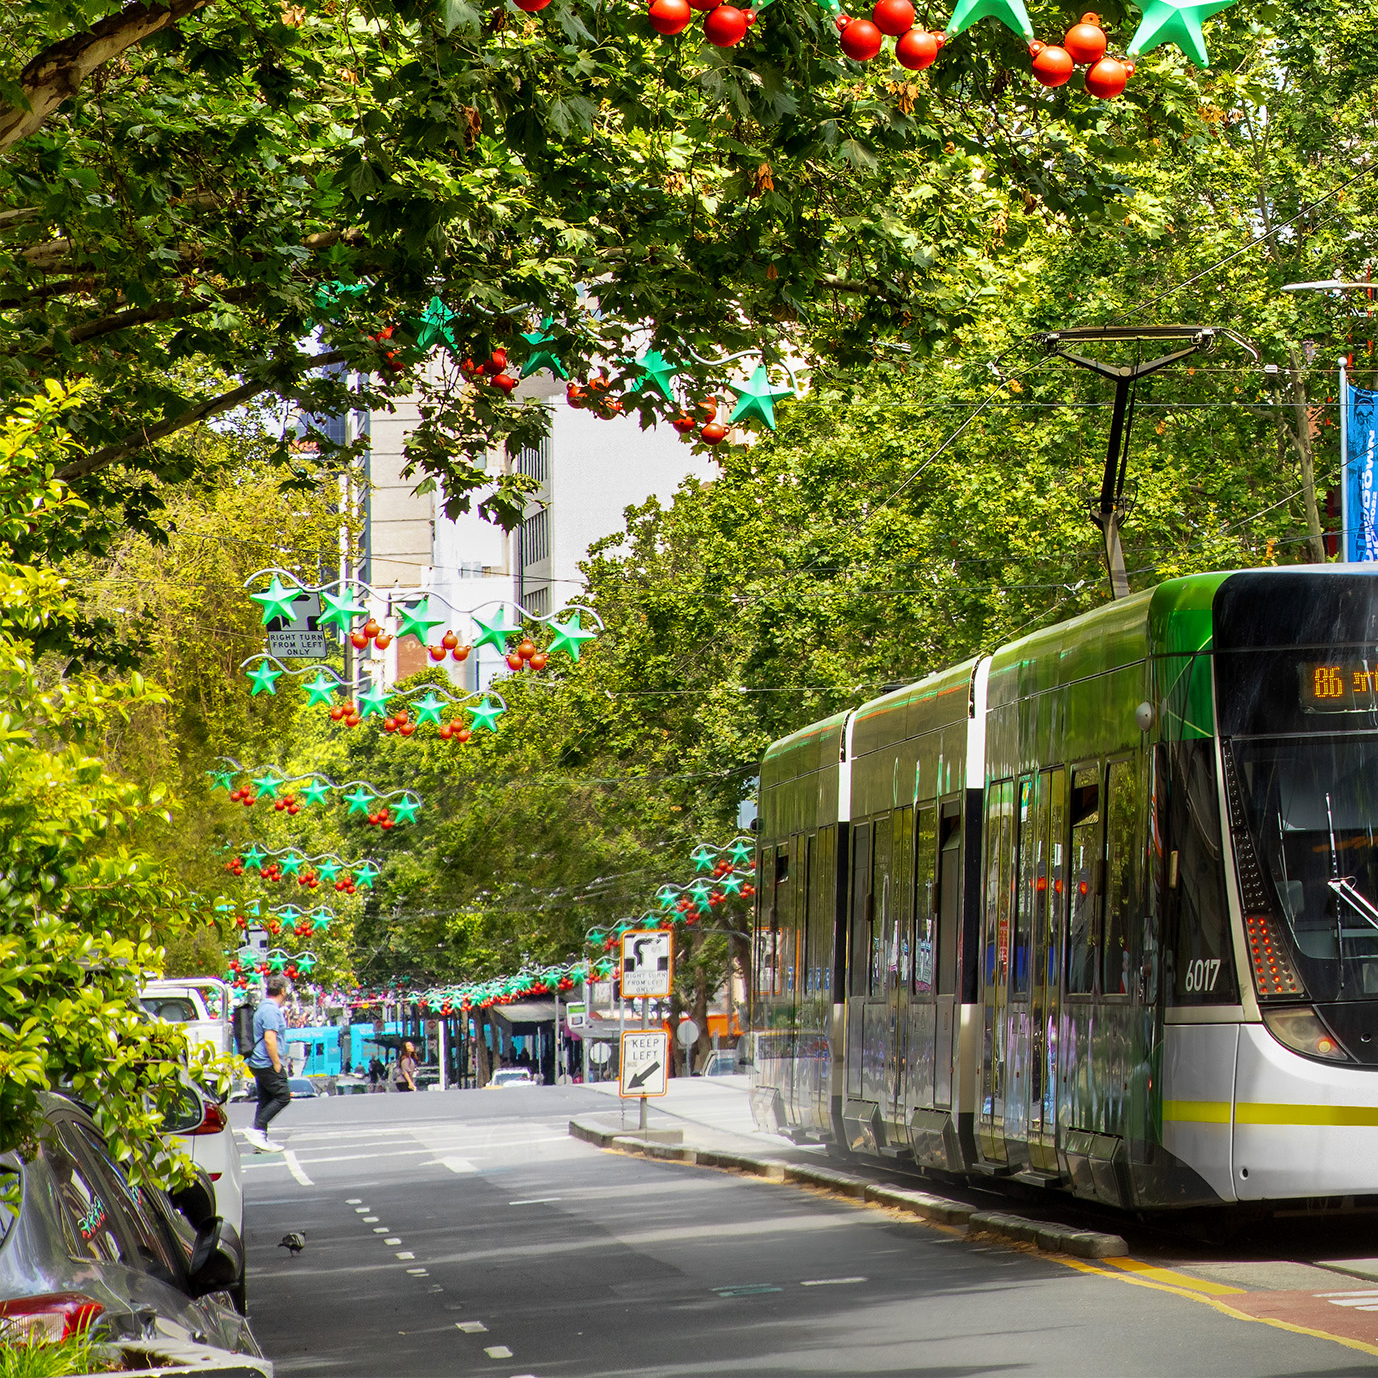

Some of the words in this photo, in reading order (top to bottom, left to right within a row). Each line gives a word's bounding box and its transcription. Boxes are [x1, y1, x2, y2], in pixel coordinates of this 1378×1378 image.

[1314, 666, 1344, 697] 86
[1185, 959, 1221, 992] 6017
[632, 1038, 660, 1048] KEEP
[633, 1050, 658, 1061] LEFT
